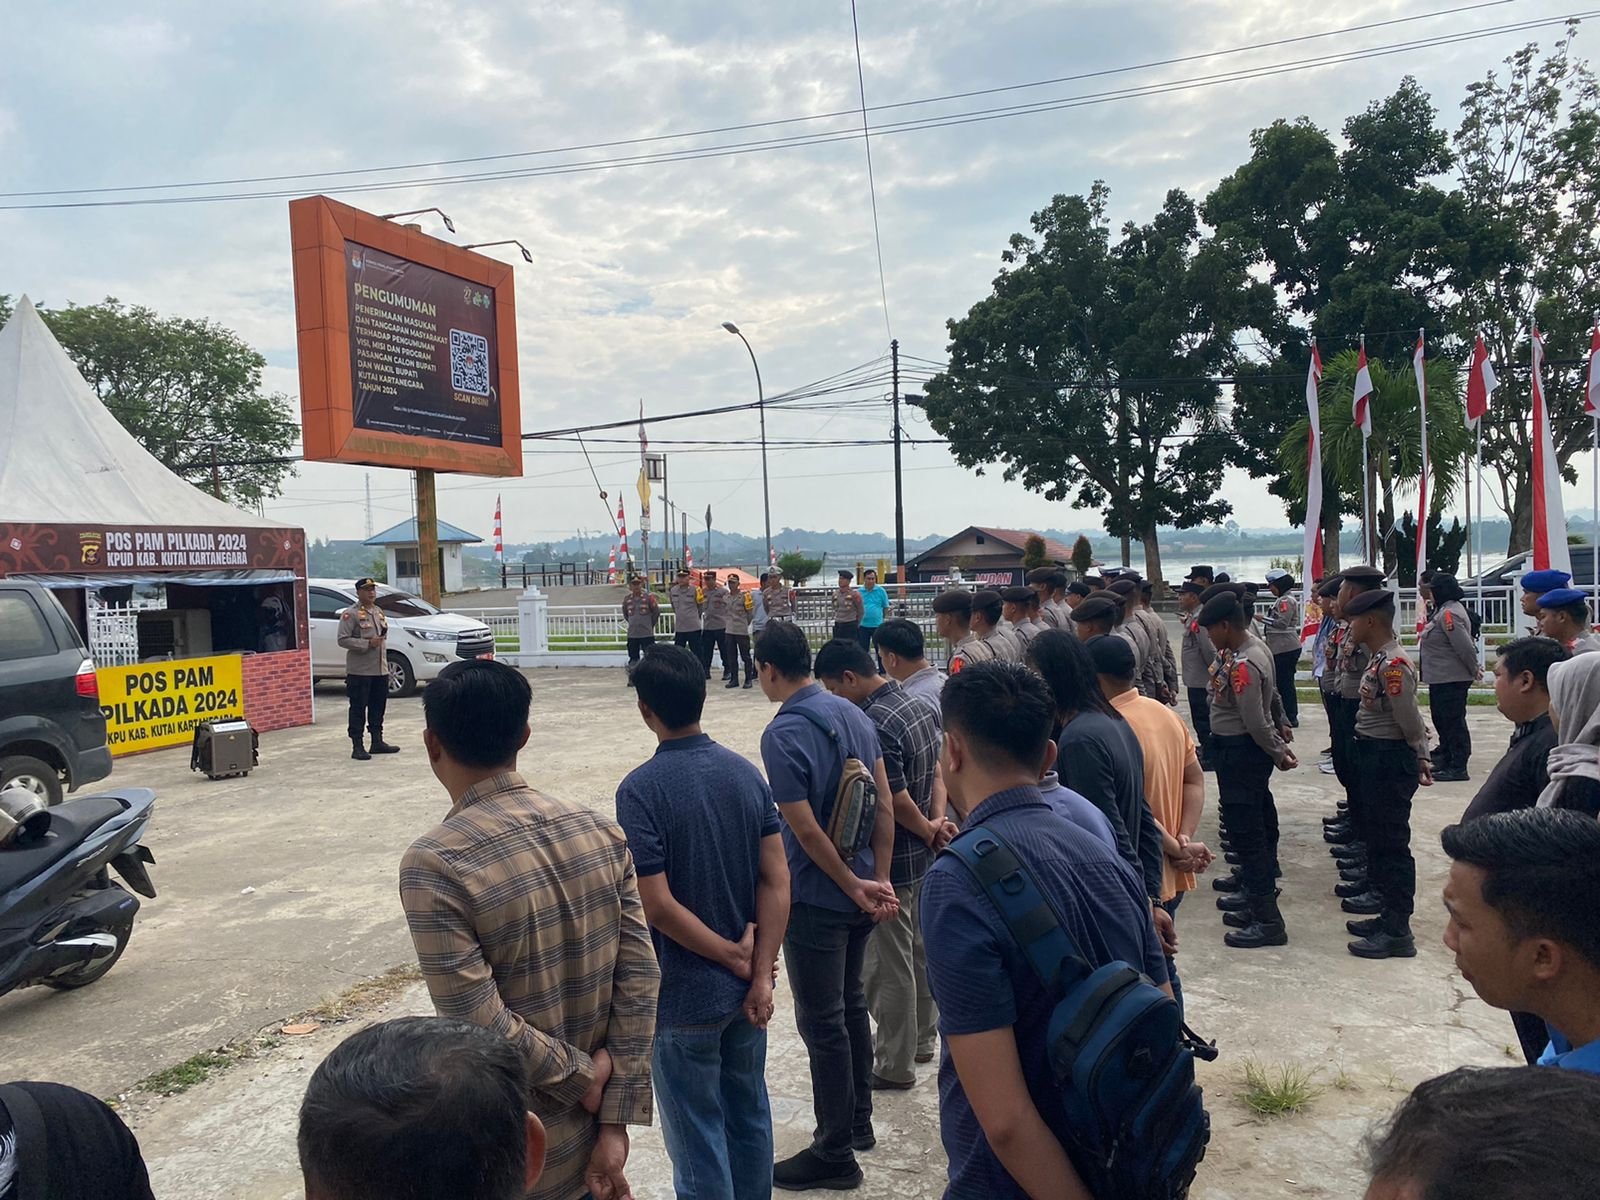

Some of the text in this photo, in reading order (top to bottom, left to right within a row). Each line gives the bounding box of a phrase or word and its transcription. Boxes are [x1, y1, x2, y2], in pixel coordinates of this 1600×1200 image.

[354, 282, 436, 317] PENGUMUMAN
[355, 304, 437, 332] PENERIMAAN MASUKAN
[355, 316, 448, 345] DAN TANGGAPAN MASYARAKAT
[356, 326, 436, 352] TERHADAP PENGUMUMAN
[357, 348, 436, 372] PASANGAN CALON BUPATI
[372, 342, 386, 351] MISI
[387, 344, 400, 354] DAN
[402, 348, 431, 361] PROGRAM
[358, 360, 418, 378] DAN WAKIL BUPATI
[358, 371, 424, 390] KUTAI KARTANEGARA
[359, 382, 397, 396] TAHUN 2024
[453, 392, 489, 407] SCAN DISINI
[105, 532, 247, 551] POS PAM PILKADA 2024
[107, 552, 248, 566] KPUD KAB. KUTAI KARTANEGARA
[126, 666, 214, 696] POS PAM
[100, 688, 238, 725] PILKADA 2024
[108, 732, 126, 745] KPU
[129, 727, 149, 741] KAB.
[151, 724, 176, 737] KUTAI
